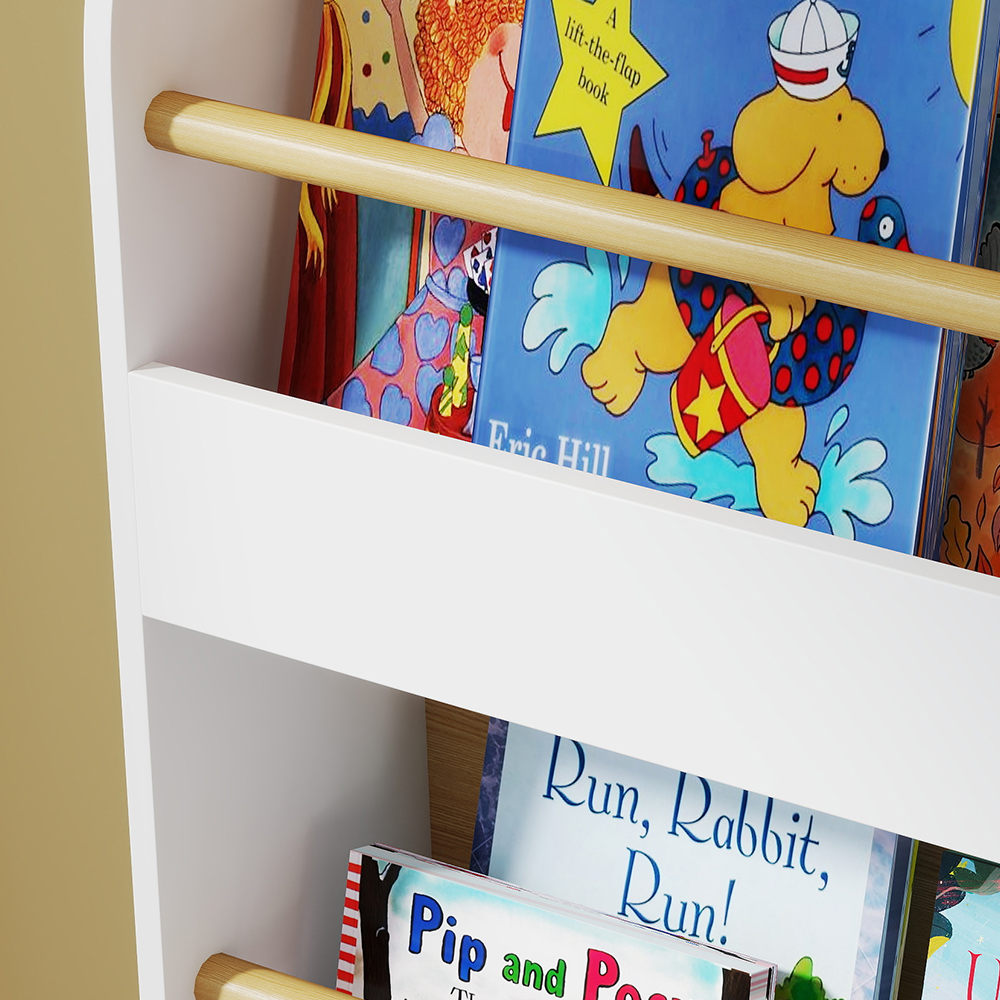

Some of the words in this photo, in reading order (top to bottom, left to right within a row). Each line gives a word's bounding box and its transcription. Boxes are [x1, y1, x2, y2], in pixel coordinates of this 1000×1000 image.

[564, 16, 641, 89] lift-the-flap
[605, 6, 617, 30] A
[577, 66, 609, 106] book
[558, 435, 610, 477] Hill
[542, 735, 650, 838] Run,
[668, 770, 829, 891] Rabbit,
[617, 847, 736, 945] Run!
[408, 892, 488, 983] Pip
[502, 952, 567, 999] and
